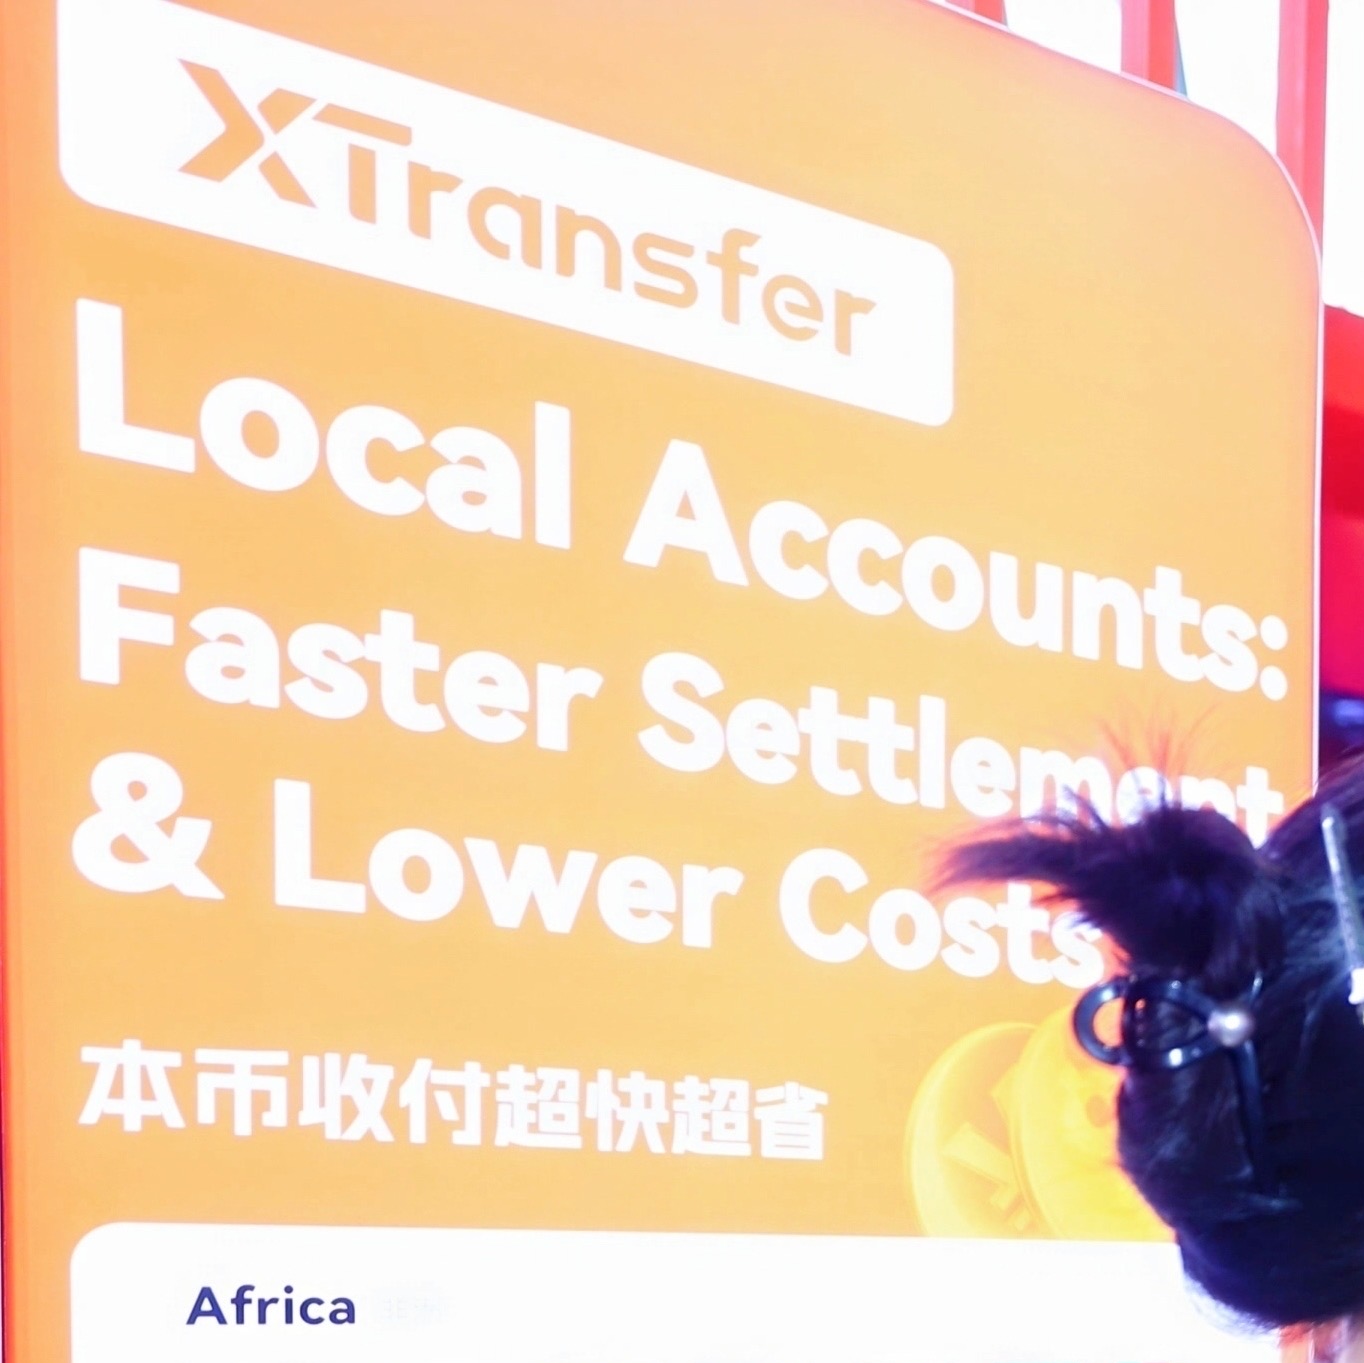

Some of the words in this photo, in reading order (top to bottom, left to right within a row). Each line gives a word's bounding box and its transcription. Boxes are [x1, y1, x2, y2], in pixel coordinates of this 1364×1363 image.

[176, 57, 877, 357] XTransfer
[75, 296, 571, 550] Local
[623, 438, 1288, 701] Accounts:
[78, 546, 604, 753] Faster
[70, 751, 225, 901] &
[272, 777, 744, 949] Lower
[778, 847, 1105, 989] Costs
[77, 1038, 829, 1163] 本币收付超快超省
[186, 1284, 357, 1326] Africa
